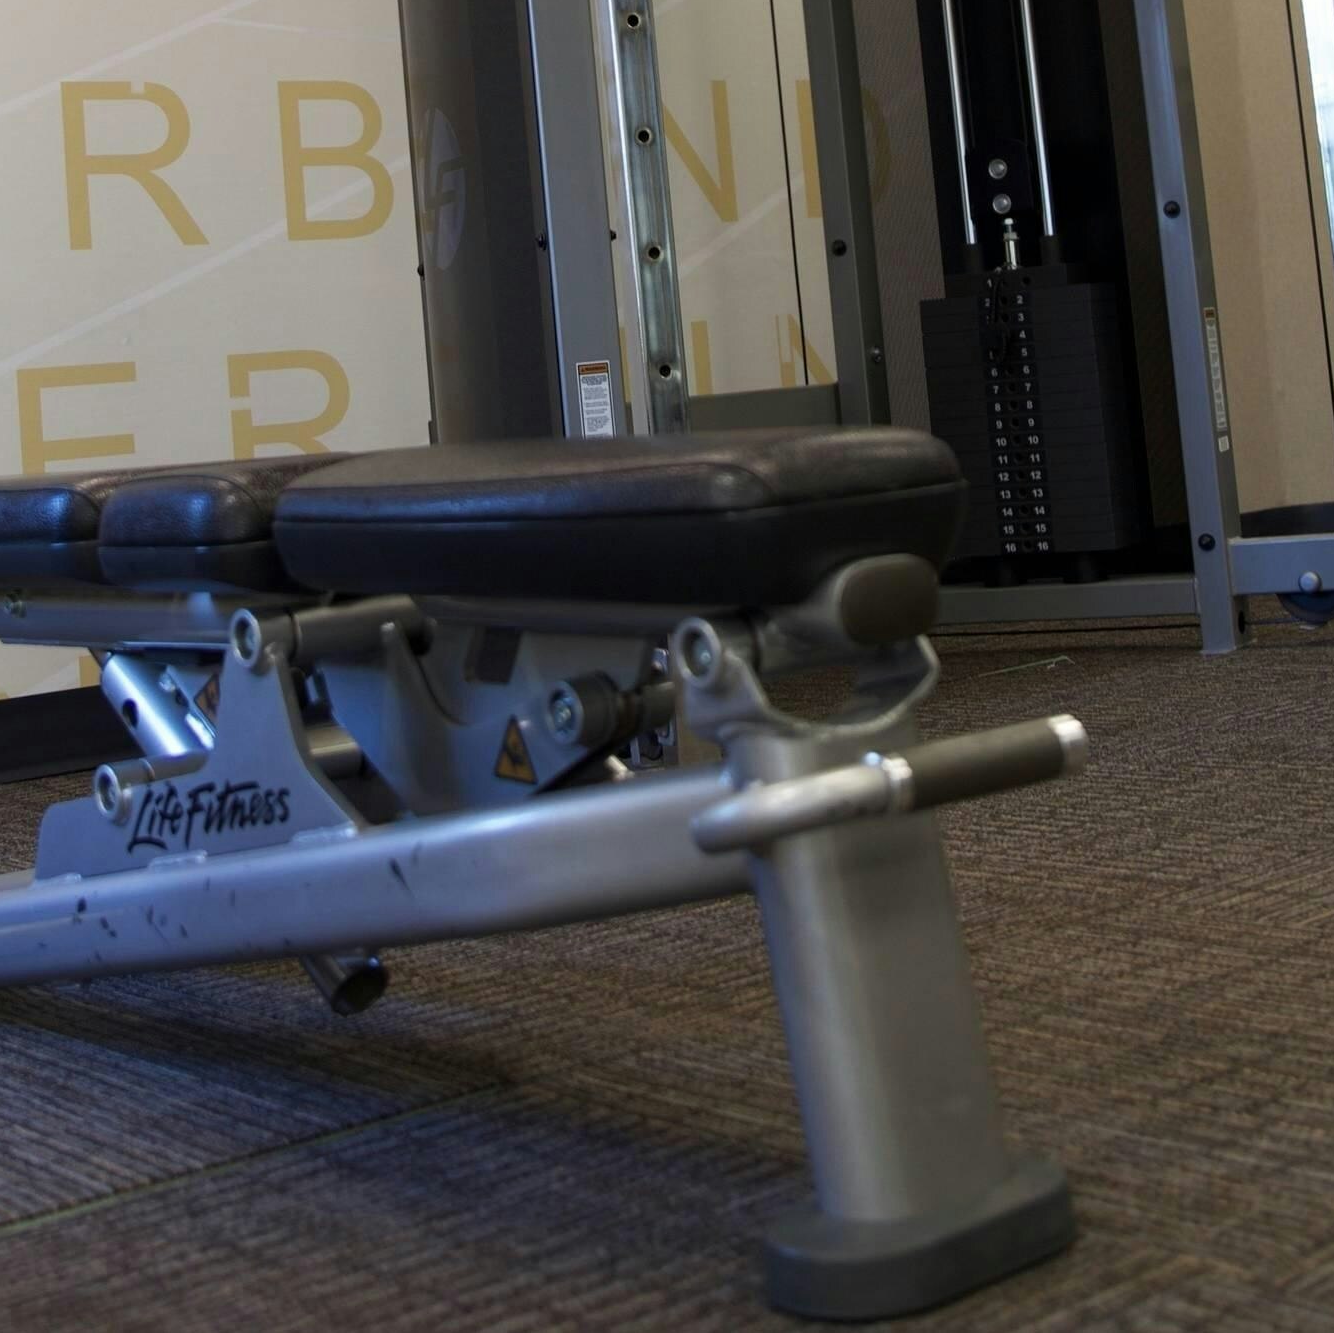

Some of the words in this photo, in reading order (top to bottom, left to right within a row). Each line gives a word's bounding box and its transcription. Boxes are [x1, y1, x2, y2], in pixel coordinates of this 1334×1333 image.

[1016, 294, 1024, 305] 2
[1017, 312, 1025, 322] 3
[1019, 329, 1027, 339] 4
[1021, 347, 1028, 357] 5
[991, 367, 999, 378] 6
[1023, 364, 1030, 375] 6
[993, 385, 999, 395] 7
[1024, 382, 1032, 392] 7
[994, 402, 1001, 413] 8
[1026, 399, 1034, 410] 8
[995, 419, 1003, 430] 9
[1027, 417, 1035, 427] 9
[995, 436, 1008, 447] 10
[1027, 434, 1040, 445] 10
[997, 454, 1008, 465] 11
[1029, 452, 1041, 463] 11
[997, 471, 1010, 482] 12
[1029, 470, 1042, 480] 12
[999, 489, 1011, 499] 13
[1032, 487, 1044, 498] 13
[1001, 506, 1014, 517] 14
[1034, 505, 1046, 516] 14
[1003, 524, 1015, 535] 15
[1035, 523, 1047, 534] 15
[1004, 542, 1017, 553] 16
[1037, 541, 1049, 552] 16
